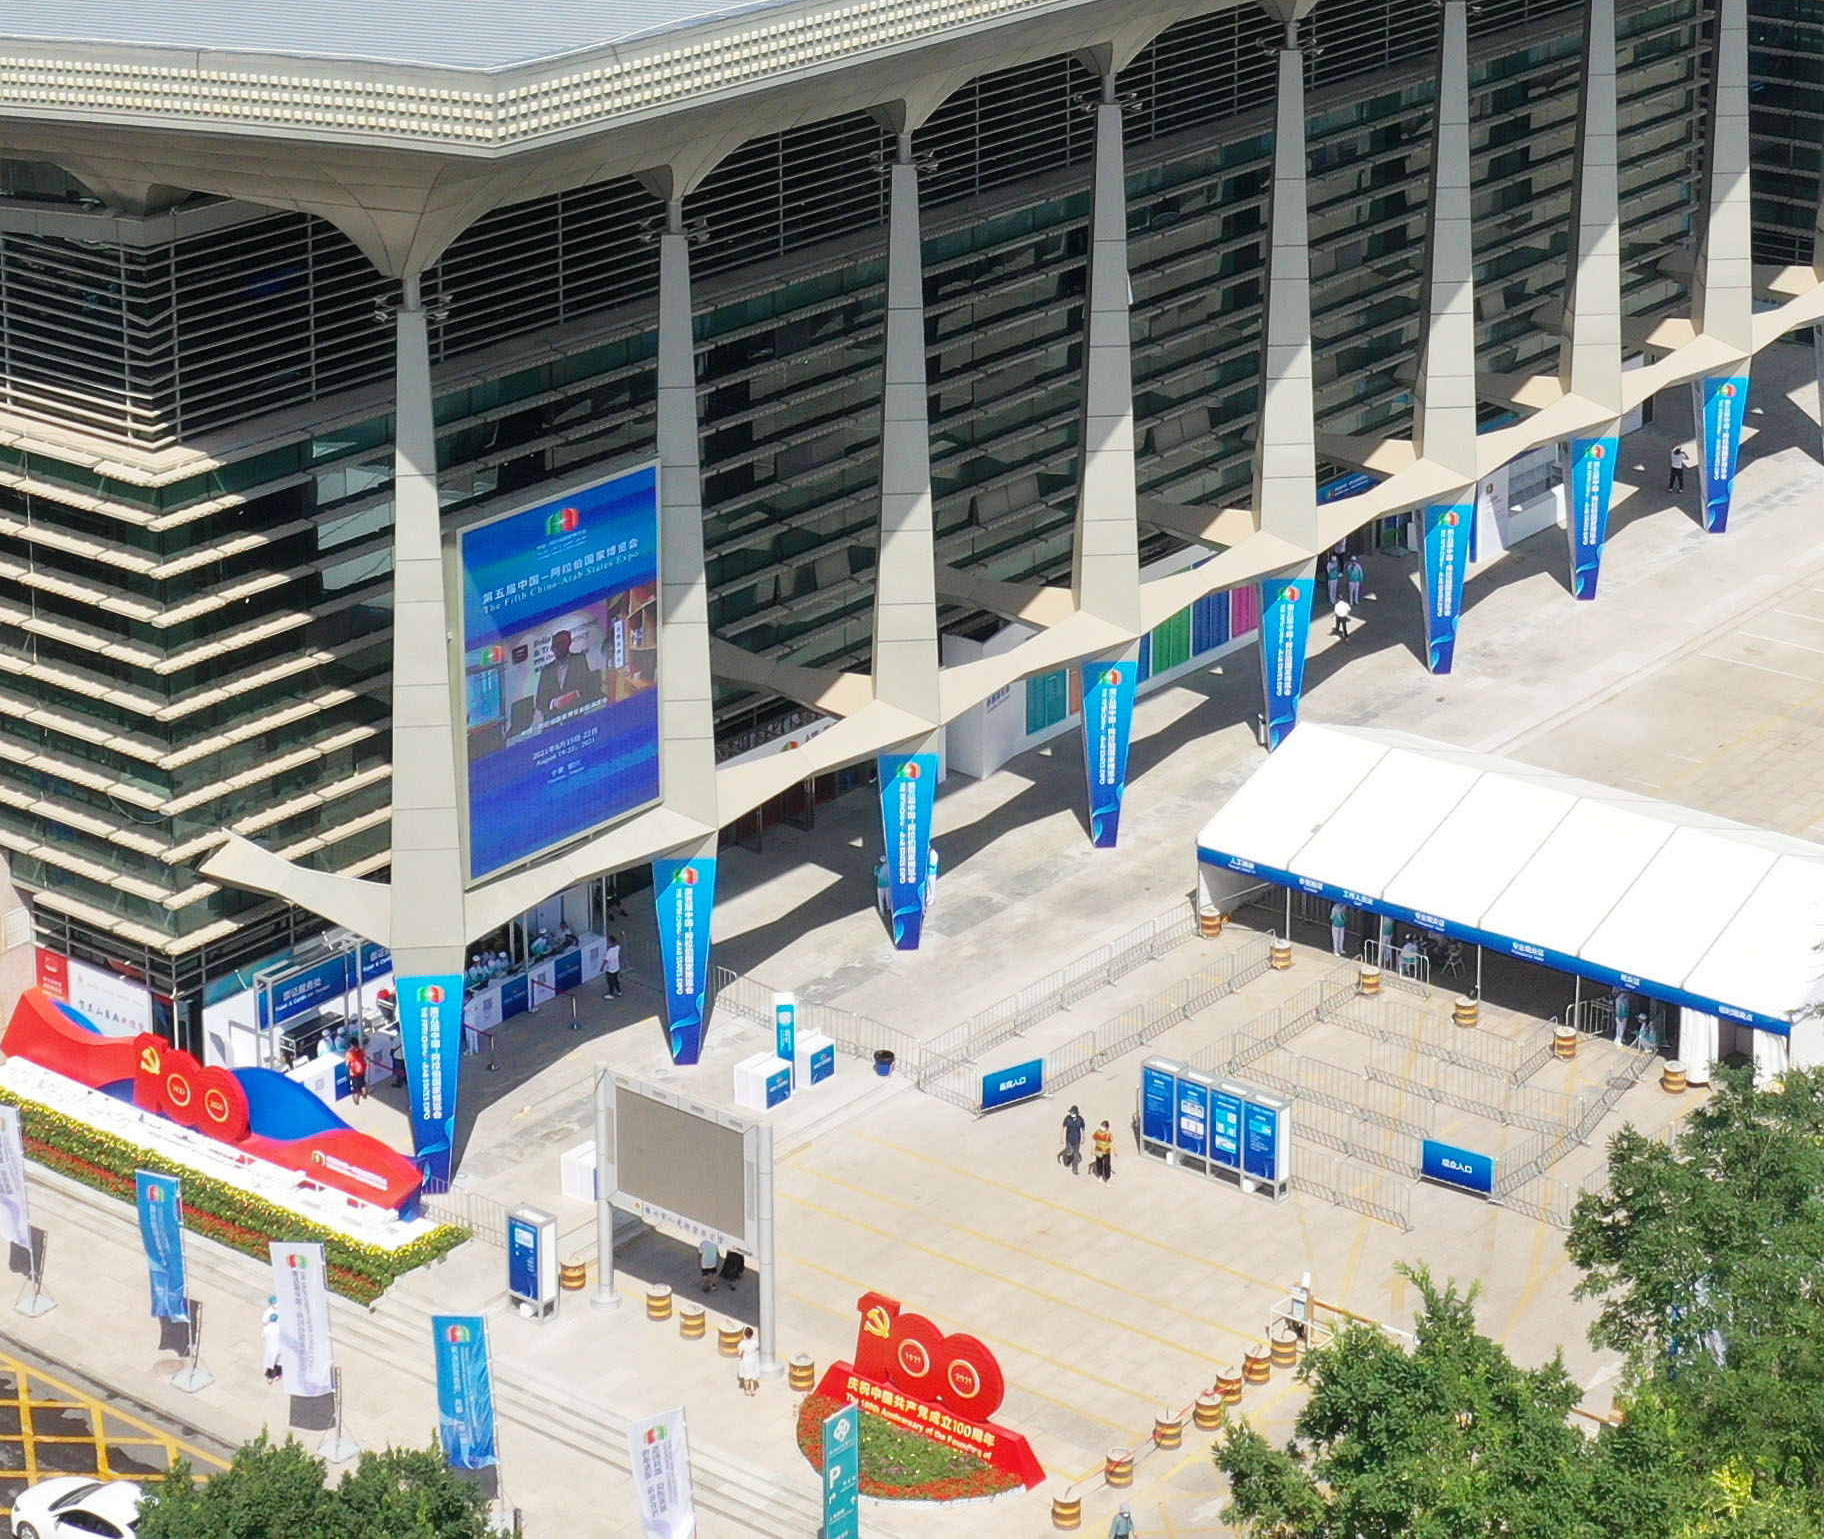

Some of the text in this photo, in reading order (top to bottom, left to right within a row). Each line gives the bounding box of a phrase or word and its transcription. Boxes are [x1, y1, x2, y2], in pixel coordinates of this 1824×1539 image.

[847, 1376, 996, 1448] 庆祝中国共产党成立100周年
[829, 1465, 842, 1490] P
